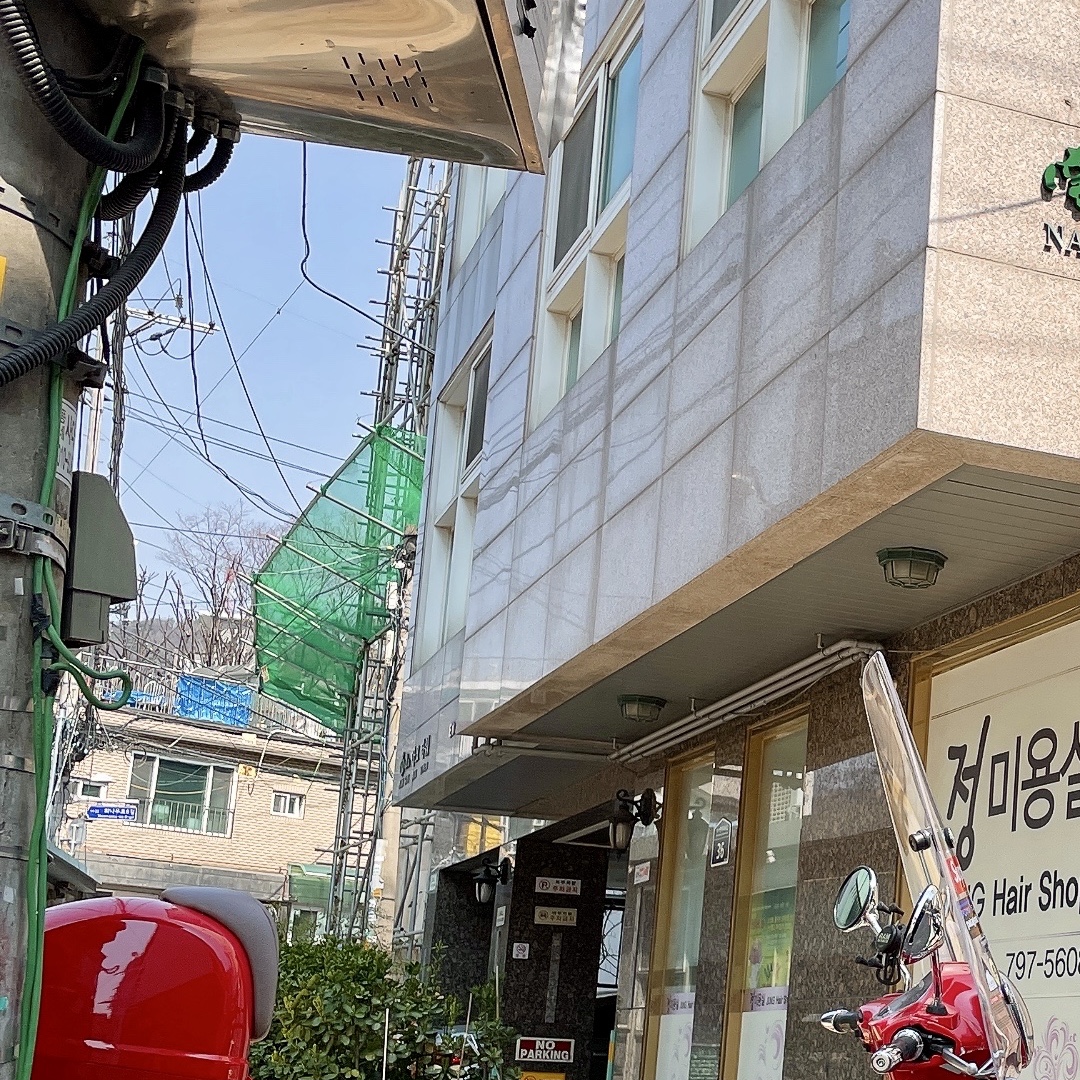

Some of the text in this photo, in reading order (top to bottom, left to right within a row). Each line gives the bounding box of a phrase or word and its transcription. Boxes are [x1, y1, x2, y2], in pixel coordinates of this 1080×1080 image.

[992, 874, 1032, 917] Hair
[535, 1040, 556, 1050] NO
[520, 1048, 569, 1061] PARKING
